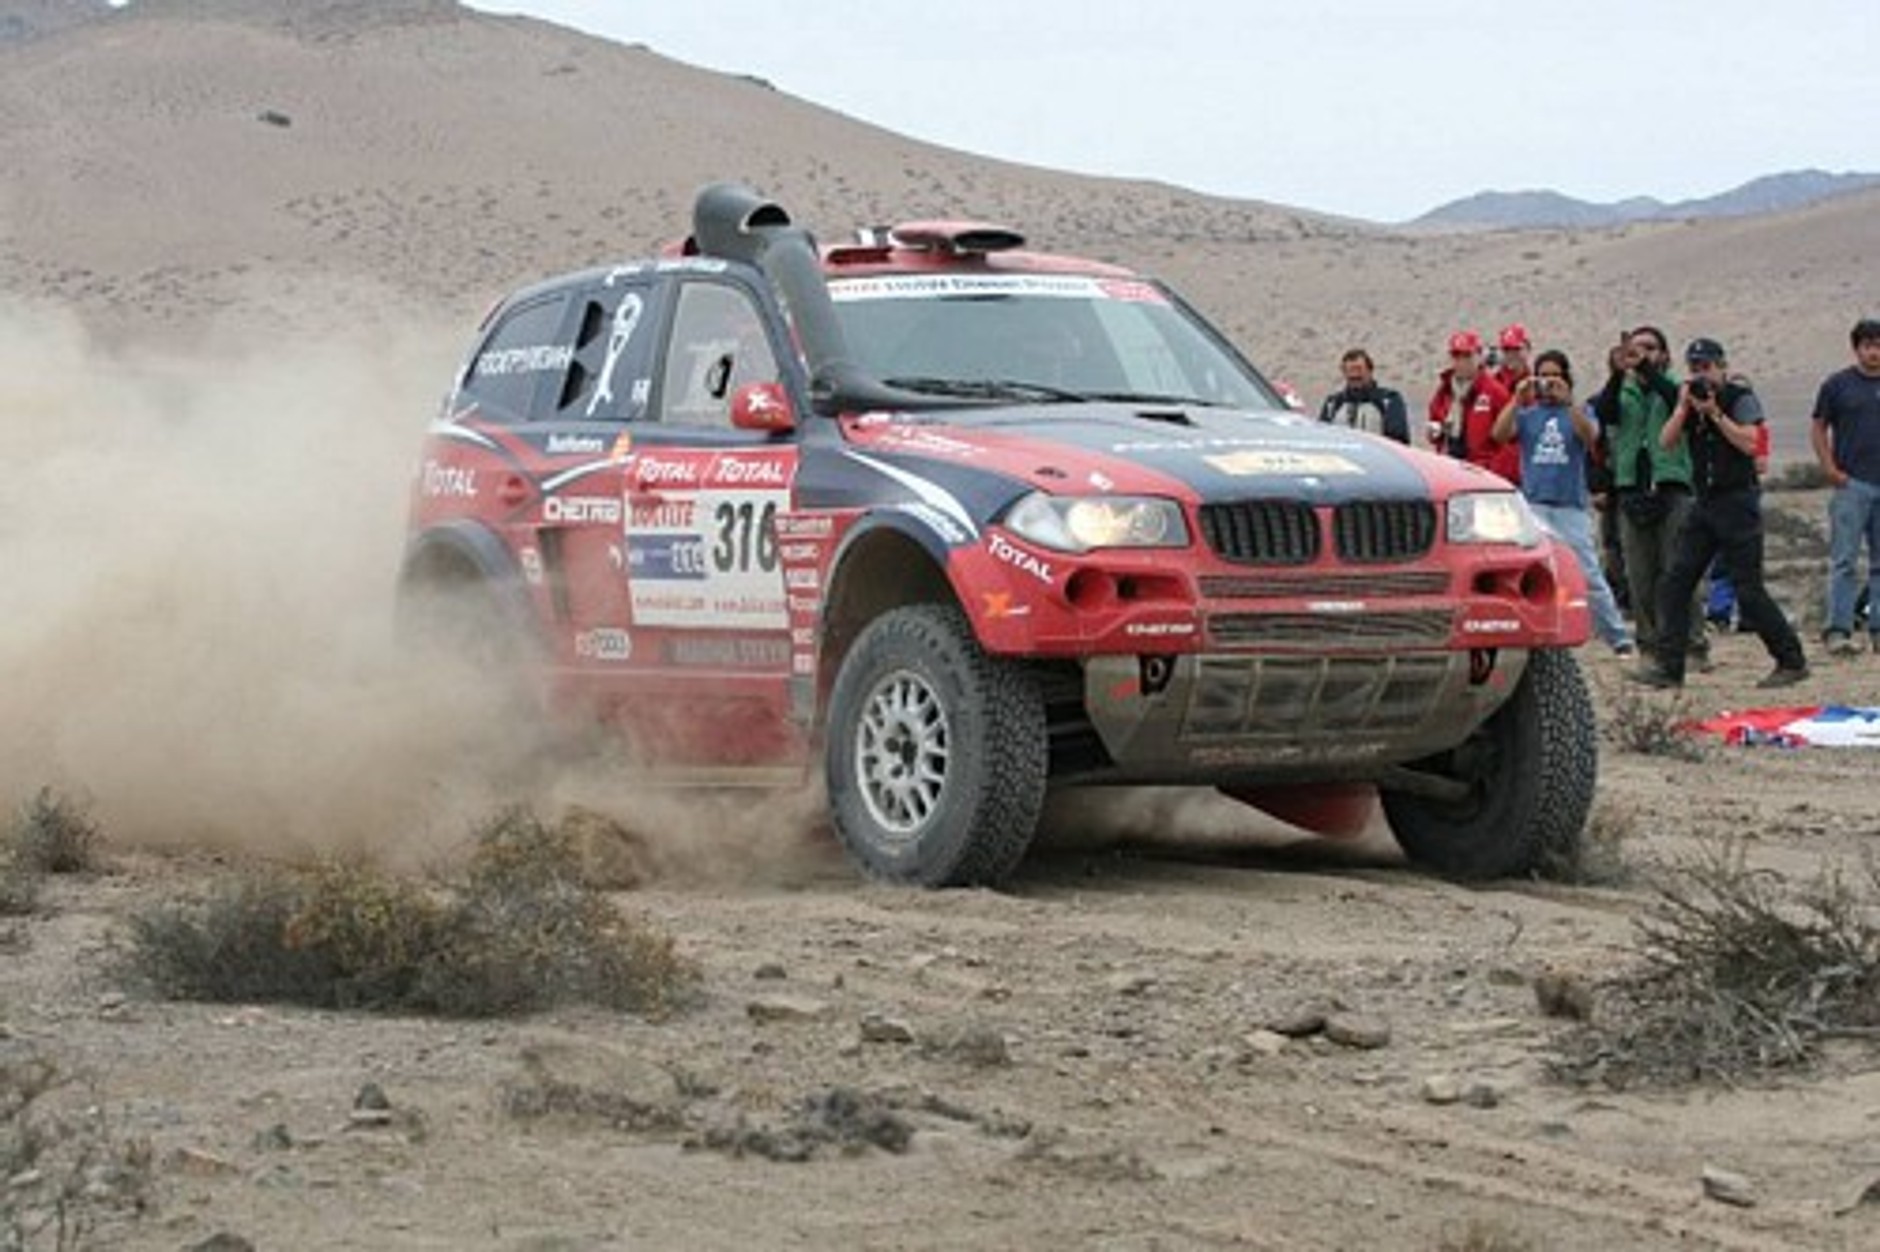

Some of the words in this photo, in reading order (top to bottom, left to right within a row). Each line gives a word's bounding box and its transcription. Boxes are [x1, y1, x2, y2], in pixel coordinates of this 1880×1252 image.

[424, 459, 479, 496] TOTAL
[637, 457, 697, 482] TOTAL
[715, 457, 785, 482] TOTAL
[714, 501, 779, 573] 316
[986, 533, 1055, 585] TOTAL
